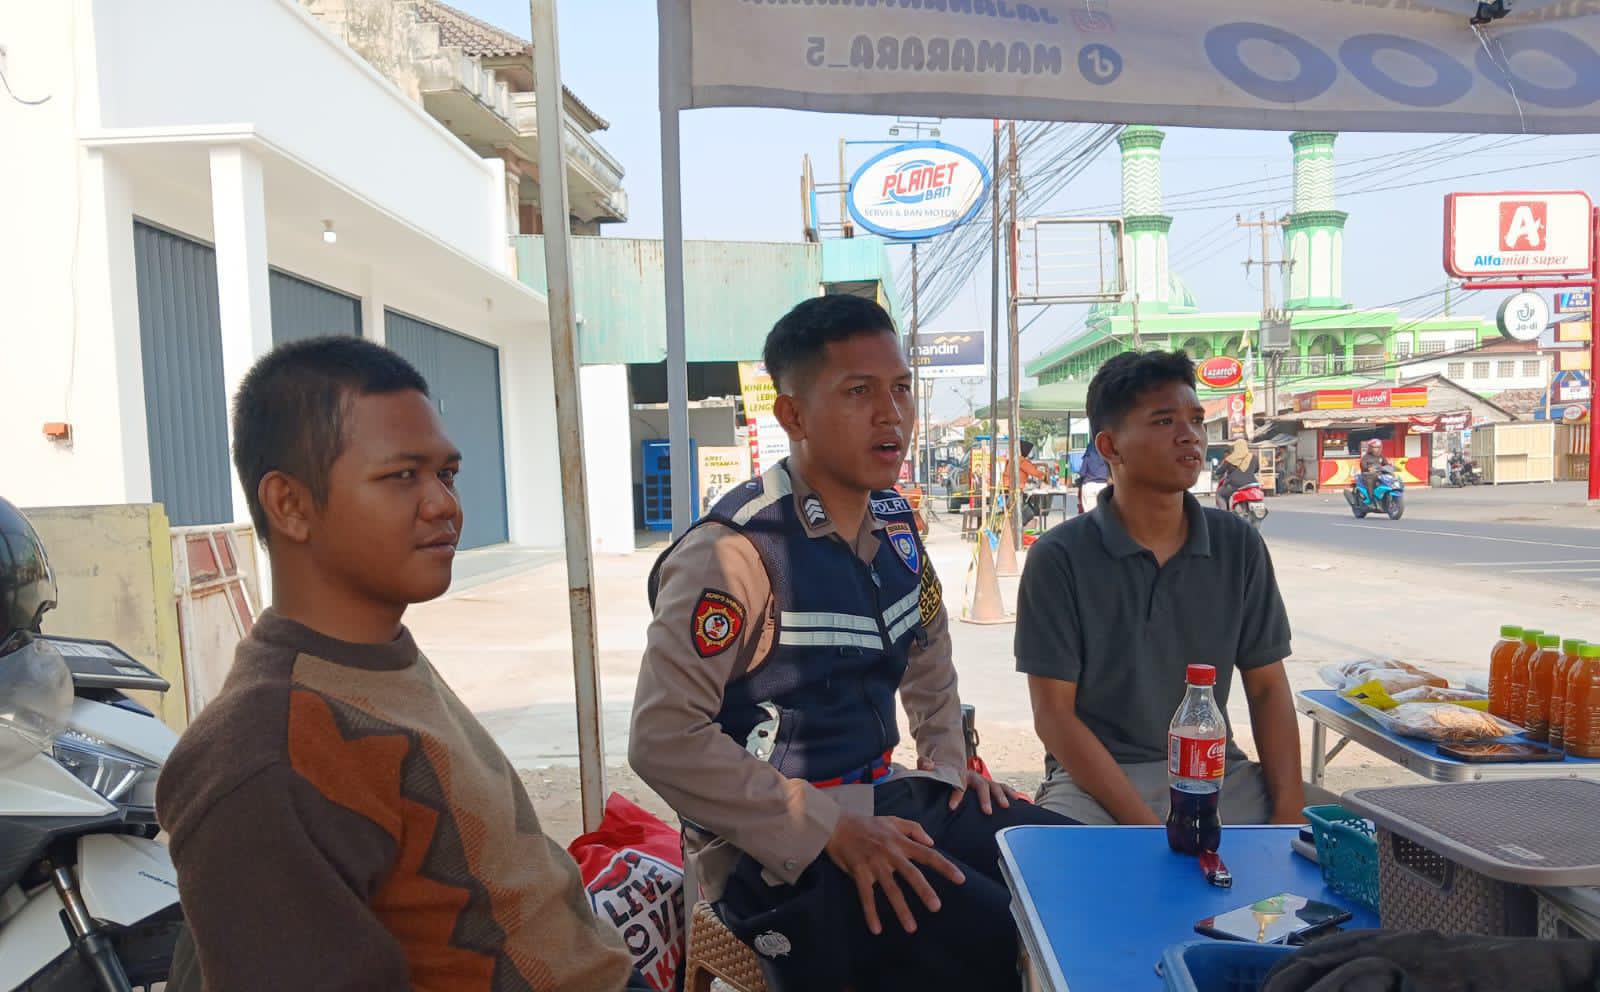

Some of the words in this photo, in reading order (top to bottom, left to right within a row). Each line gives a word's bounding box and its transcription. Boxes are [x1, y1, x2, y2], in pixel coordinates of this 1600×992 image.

[882, 161, 959, 197] PLANET
[925, 185, 952, 201] BAN
[1474, 254, 1529, 267] Alfamidi
[1532, 255, 1568, 266] super
[872, 500, 908, 512] POLRI
[603, 868, 672, 928] LIVE
